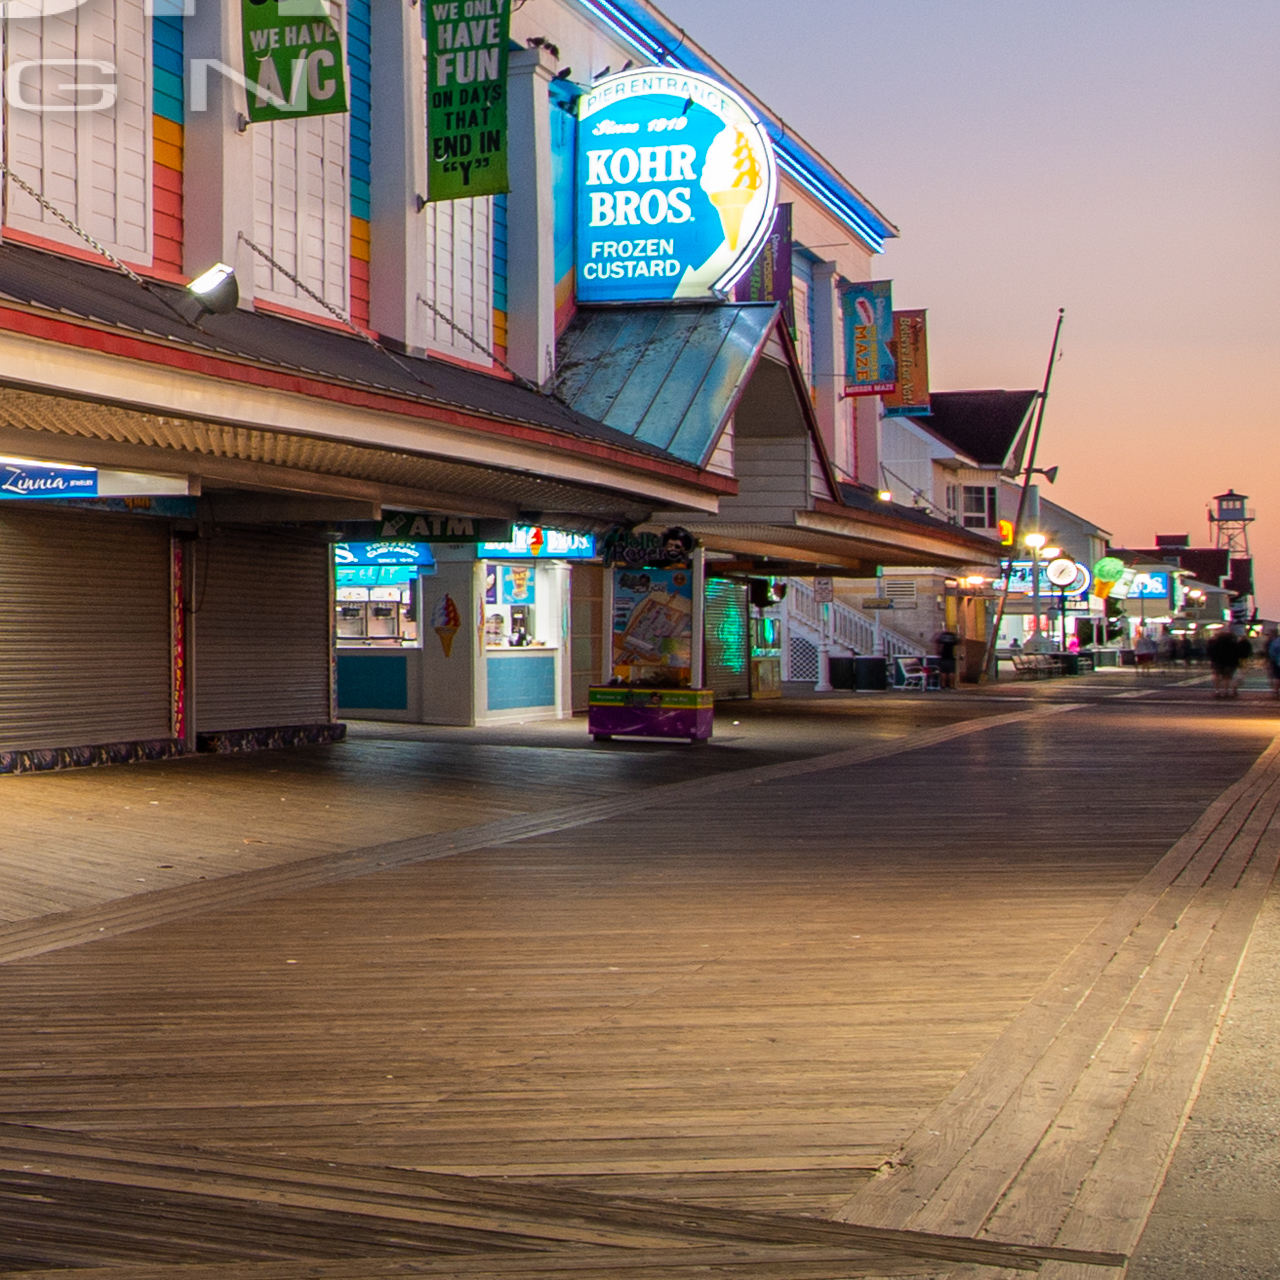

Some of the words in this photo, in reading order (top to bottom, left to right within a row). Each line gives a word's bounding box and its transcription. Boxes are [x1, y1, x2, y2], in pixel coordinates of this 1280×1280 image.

[432, 3, 460, 21] WE
[250, 27, 279, 52] WE
[285, 23, 338, 45] HAVE
[439, 20, 500, 50] HAVE
[255, 49, 337, 108] A/C
[437, 48, 499, 86] FUN
[432, 90, 455, 109] ON
[460, 84, 502, 106] DAYS
[587, 83, 626, 111] PIER
[631, 77, 731, 115] ENTRANCE
[444, 107, 490, 130] THAT
[433, 135, 471, 159] END
[479, 129, 501, 152] IN
[586, 144, 697, 185] KOHR
[589, 187, 696, 227] BROS.
[591, 239, 674, 258] FROZEN
[583, 260, 681, 279] CUSTARD
[854, 325, 870, 381] MAZE
[1, 465, 68, 494] Zinnia
[408, 518, 474, 537] ATM
